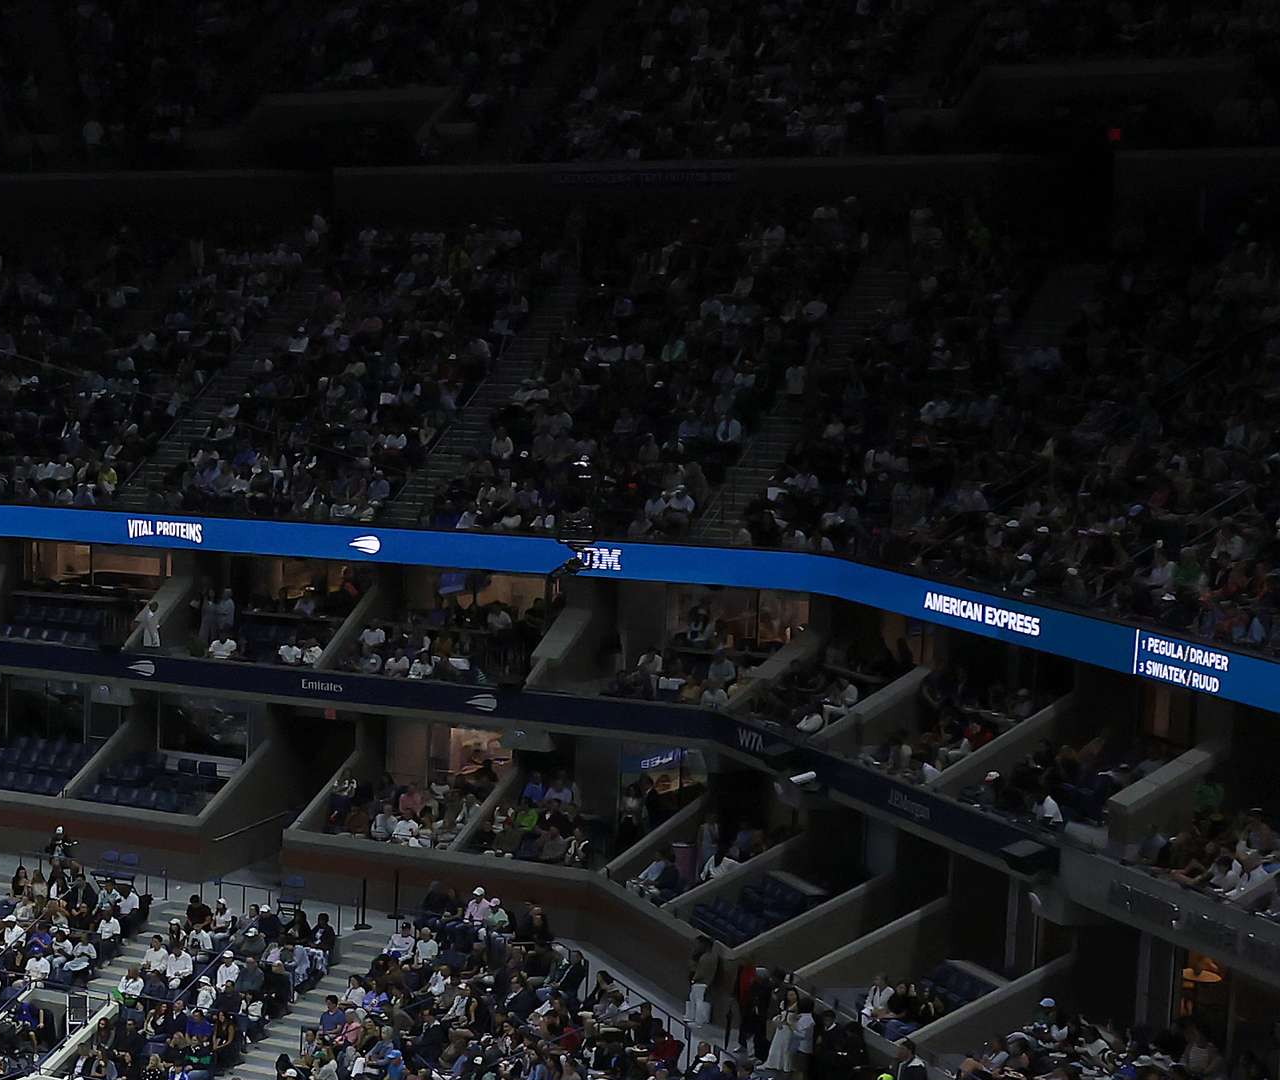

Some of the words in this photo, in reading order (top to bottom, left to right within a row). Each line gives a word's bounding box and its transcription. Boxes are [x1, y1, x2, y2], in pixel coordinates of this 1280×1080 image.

[128, 519, 152, 538] VITAL
[159, 520, 203, 544] PROTEINS
[577, 547, 622, 571] BM
[924, 592, 981, 621] AMERICAN
[984, 606, 1041, 636] EXPRESS
[1141, 639, 1146, 650] 1
[1138, 662, 1145, 673] 3
[300, 677, 343, 693] Emirates
